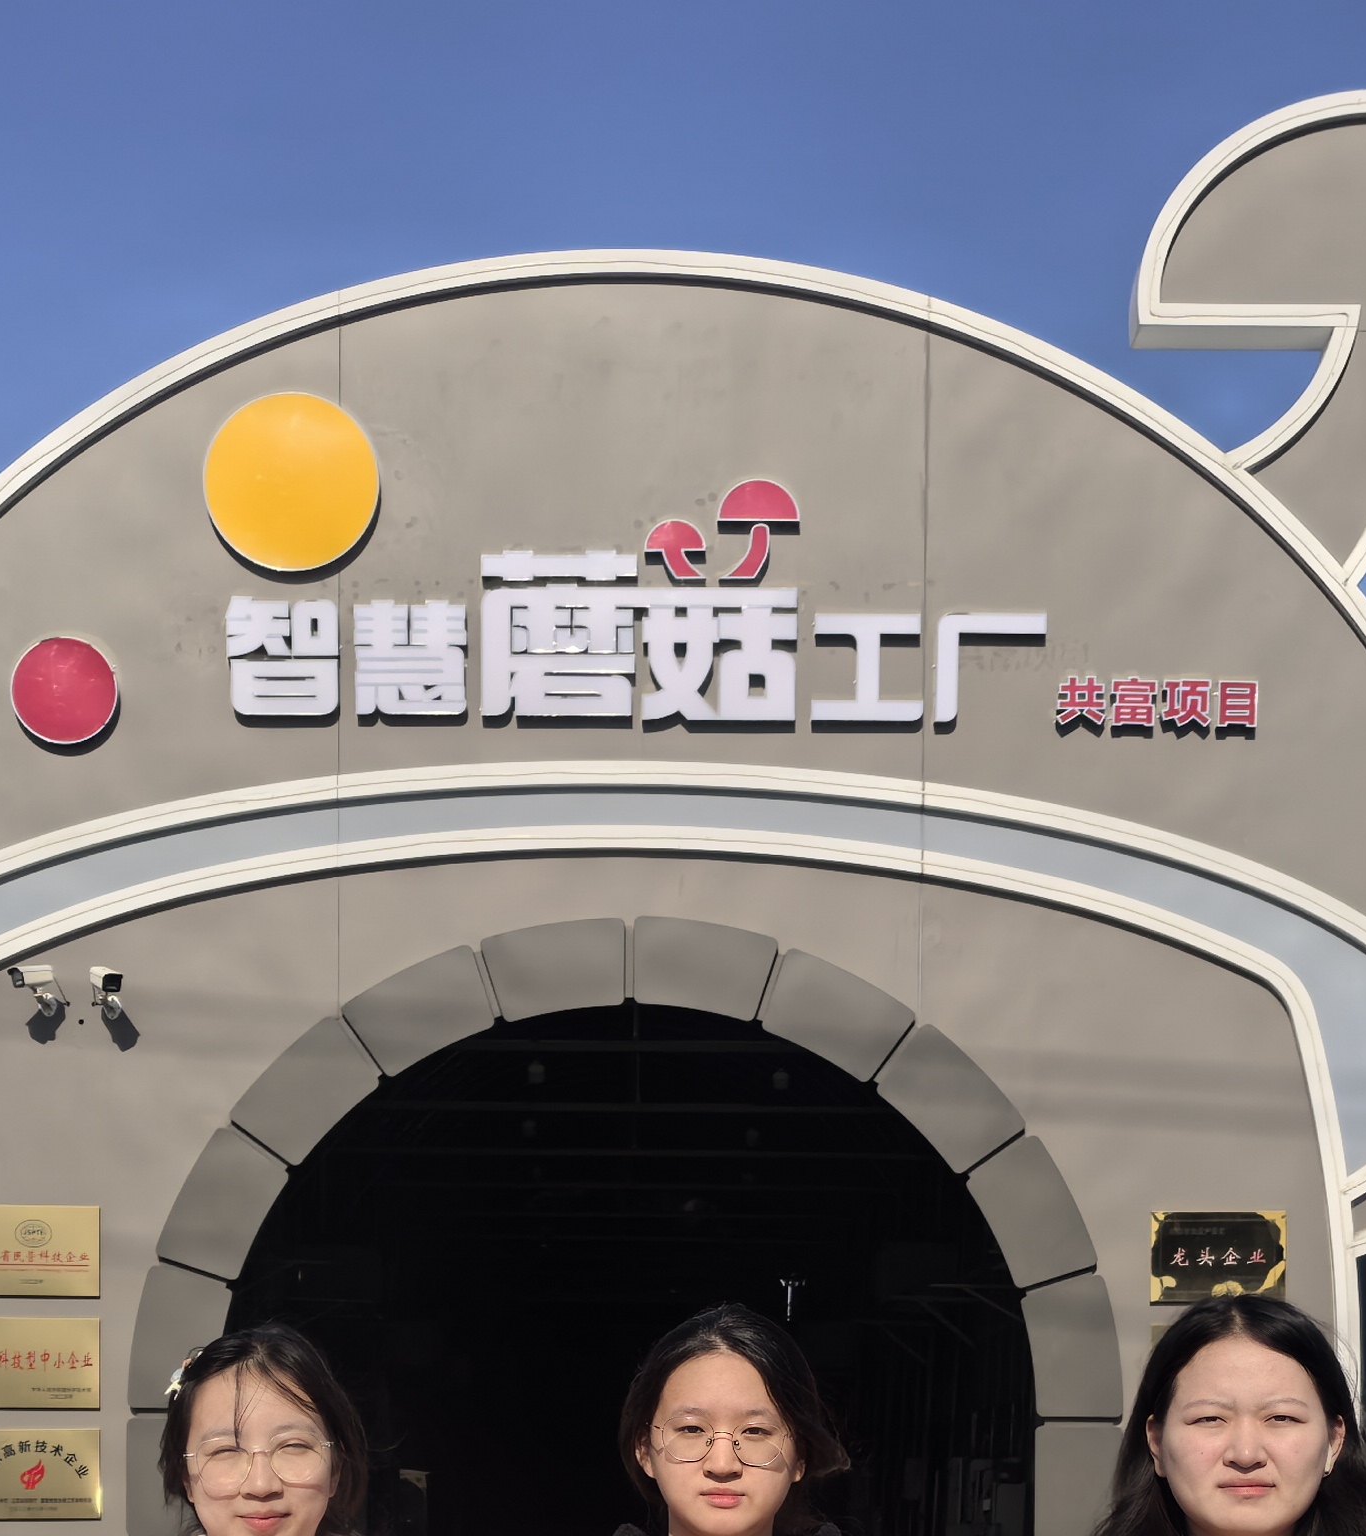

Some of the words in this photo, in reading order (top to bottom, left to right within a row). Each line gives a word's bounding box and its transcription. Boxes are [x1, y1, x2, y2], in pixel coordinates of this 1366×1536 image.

[226, 479, 1047, 723] 智慧蘑菇工厂
[1056, 676, 1259, 729] 共富项目
[1169, 1247, 1267, 1267] 龙头企业
